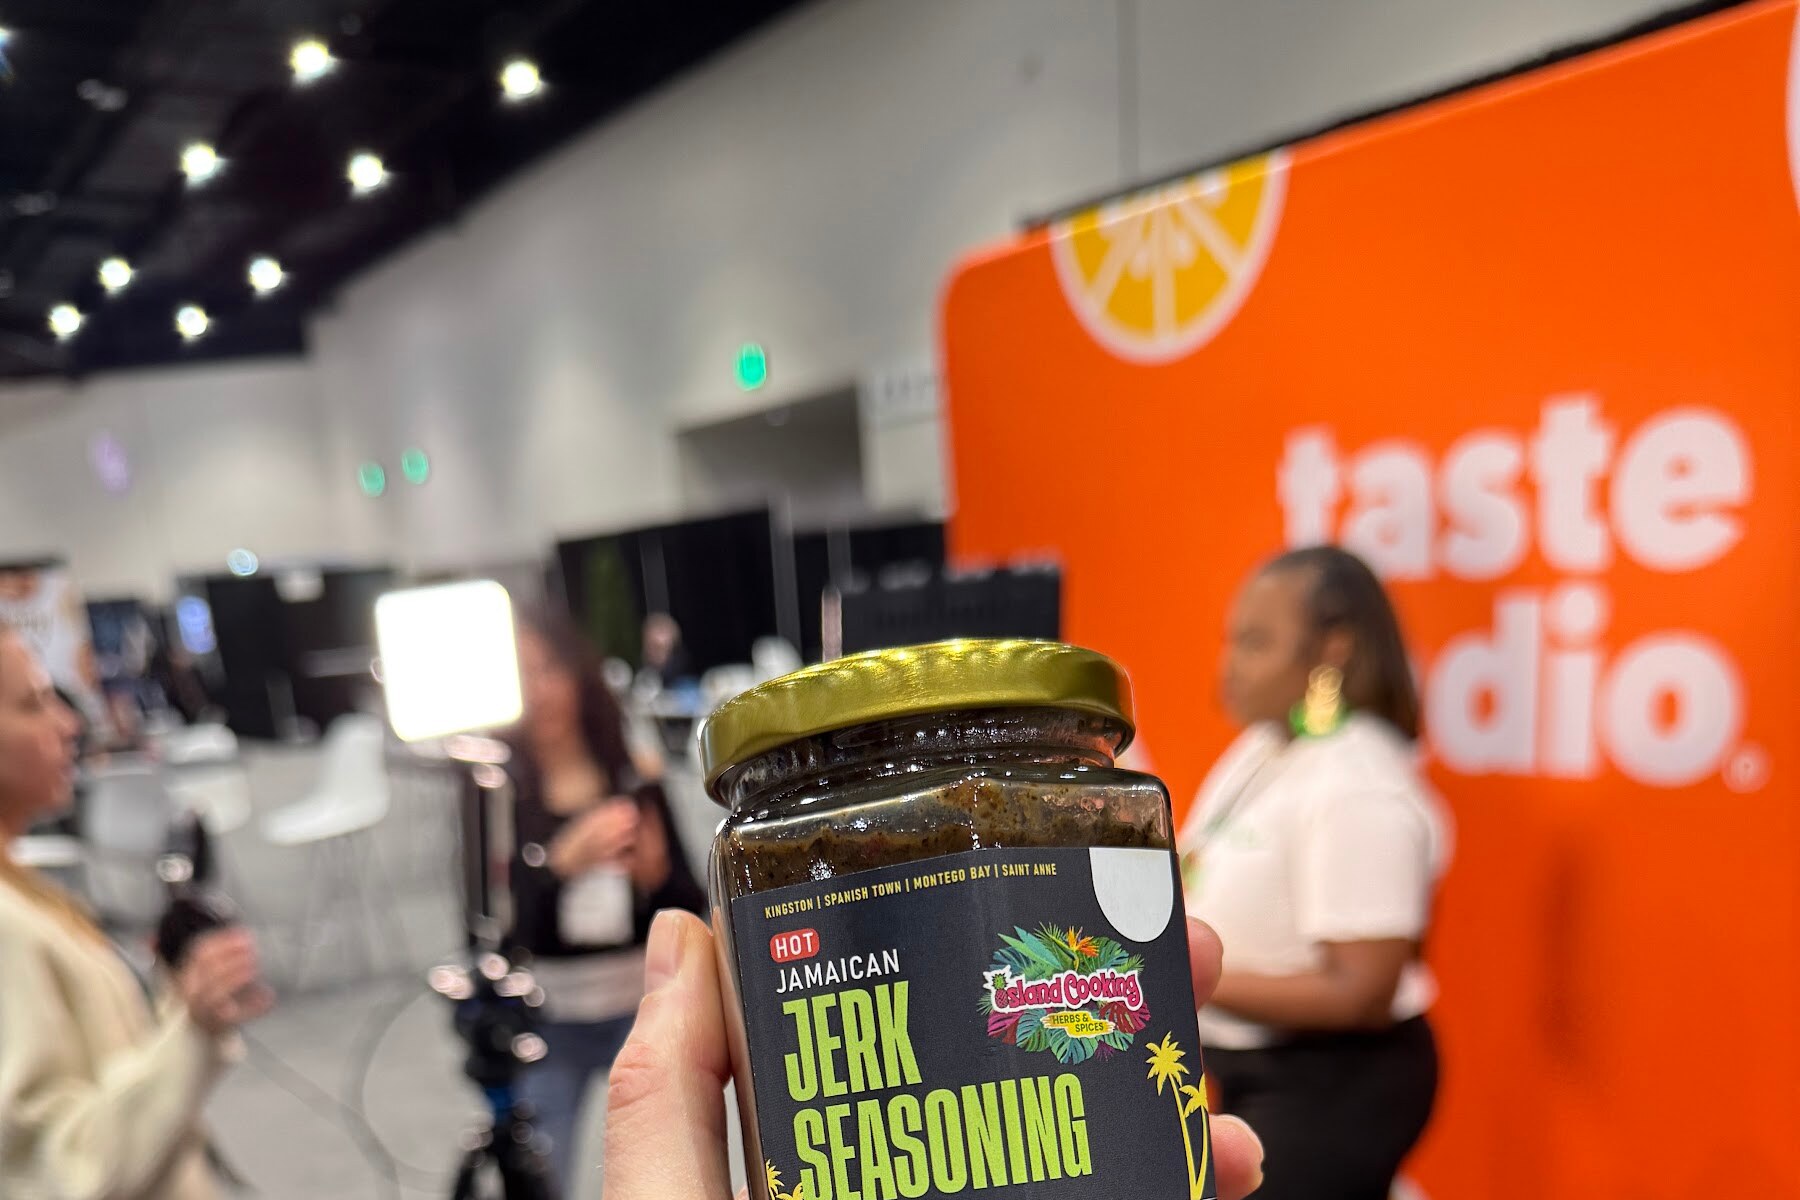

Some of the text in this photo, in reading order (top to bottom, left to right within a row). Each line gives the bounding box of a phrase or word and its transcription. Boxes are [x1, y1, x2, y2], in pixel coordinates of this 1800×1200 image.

[1277, 393, 1753, 581] taste
[764, 897, 814, 919] KINGSTON
[824, 886, 869, 908] SPANISH
[871, 880, 902, 898] TOWN
[913, 868, 966, 890] MONTEGO
[969, 864, 991, 880] BAY
[1001, 863, 1030, 877] SAINT
[1033, 862, 1057, 876] ANNE
[774, 931, 814, 959] HOT
[775, 948, 900, 994] JAMAICAN
[1063, 970, 1142, 1007] Cooking
[1052, 1014, 1089, 1025] HERBS &
[1075, 1022, 1104, 1033] SPICES
[782, 980, 922, 1102] JERK
